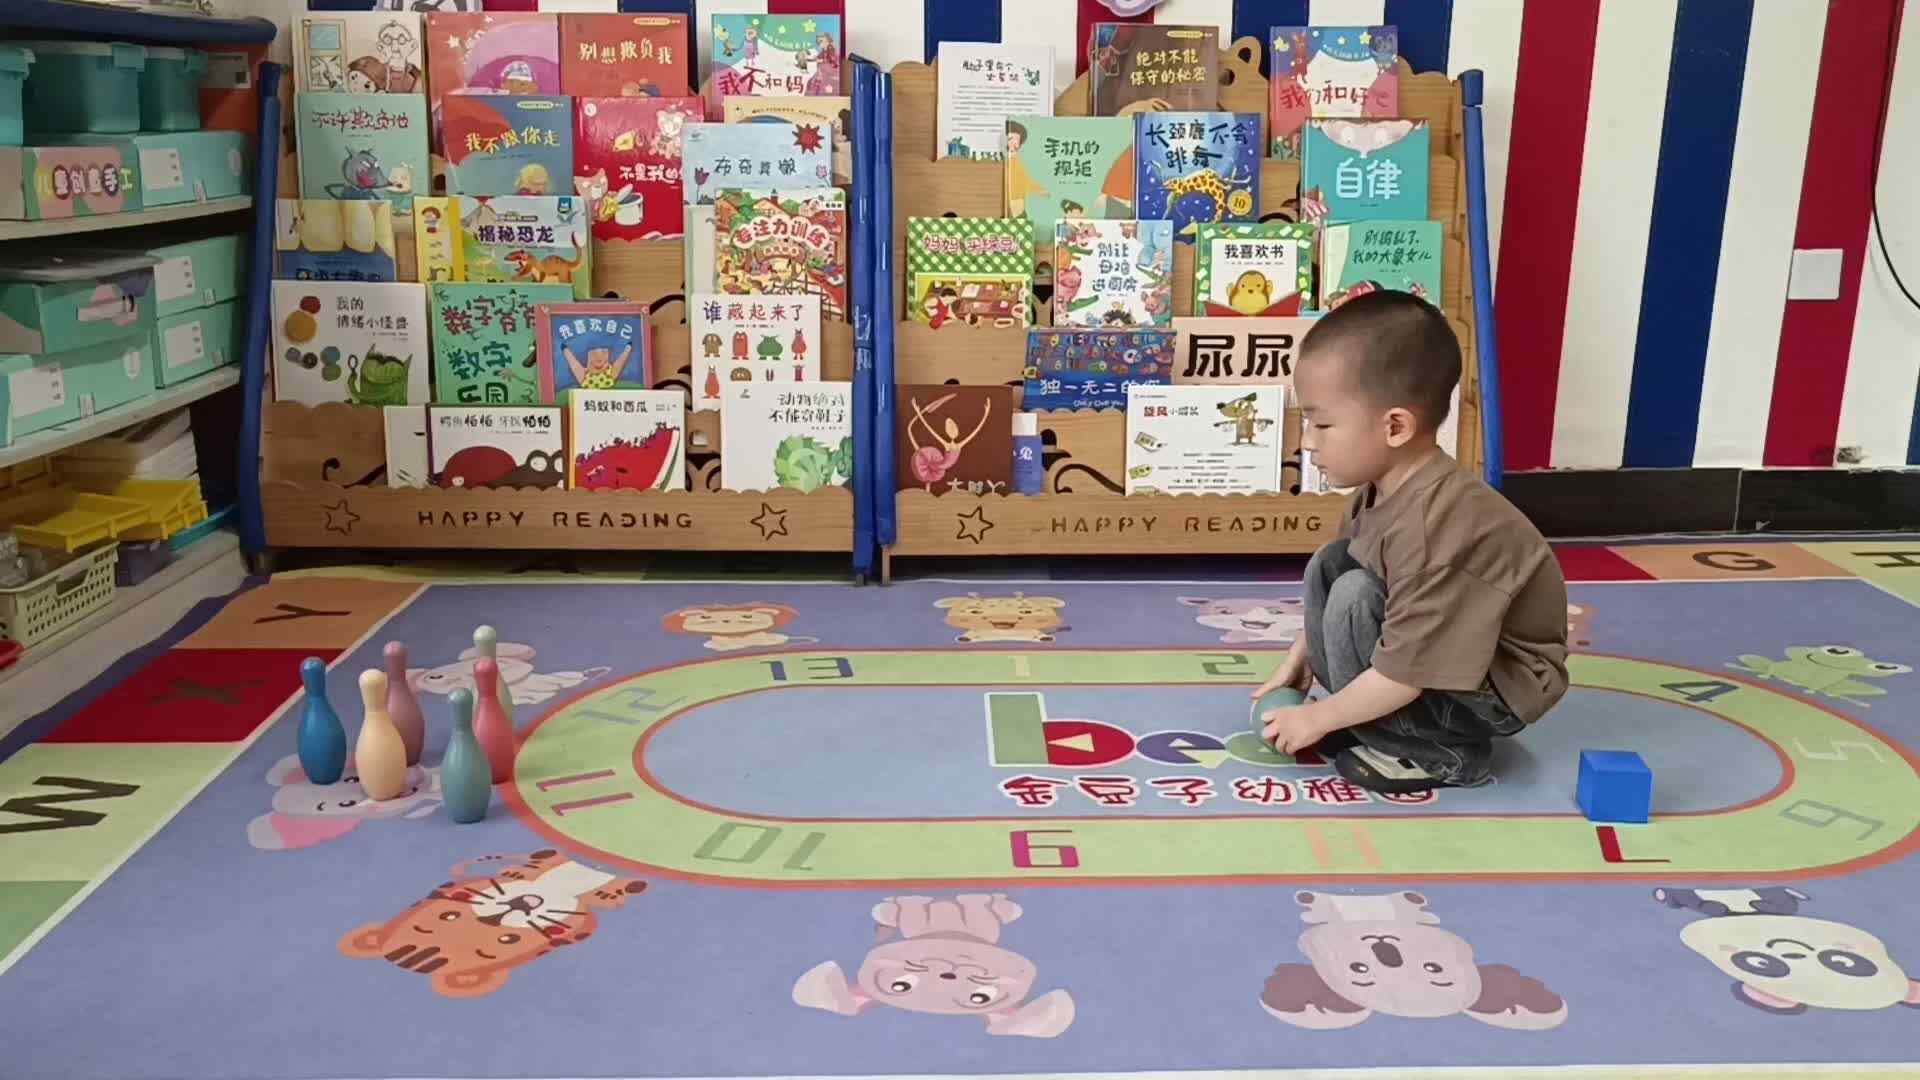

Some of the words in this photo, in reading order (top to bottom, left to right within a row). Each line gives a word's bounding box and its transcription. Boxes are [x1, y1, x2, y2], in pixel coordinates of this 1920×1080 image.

[1136, 48, 1199, 66] 绝对不能
[1130, 67, 1207, 86] 保守的秘密
[465, 126, 561, 155] 我不跟你走
[1145, 119, 1249, 148] 长颈鹿不会
[1043, 137, 1100, 158] 手机的
[1053, 159, 1093, 178] 规矩
[1165, 145, 1223, 174] 跳舞
[1335, 157, 1402, 200] 自律
[478, 225, 555, 243] 揭秘恐龙
[1224, 243, 1285, 260] 我喜欢书
[335, 296, 365, 311] 我的
[702, 301, 805, 324] 谁藏起来了
[559, 318, 634, 341] 我喜欢自己
[1182, 333, 1295, 378] 尿尿
[584, 399, 649, 414] 蚂蚁和西瓜
[418, 511, 525, 527] HAPPY
[552, 512, 693, 529] READING
[1051, 516, 1158, 533] HAPPY
[1184, 516, 1323, 533] READING
[1691, 551, 1777, 571] G
[252, 603, 352, 624] Y
[760, 657, 854, 681] 13
[1007, 655, 1031, 677] 1
[1197, 653, 1256, 676] 2
[1660, 681, 1740, 703] 4
[535, 768, 635, 817] 11
